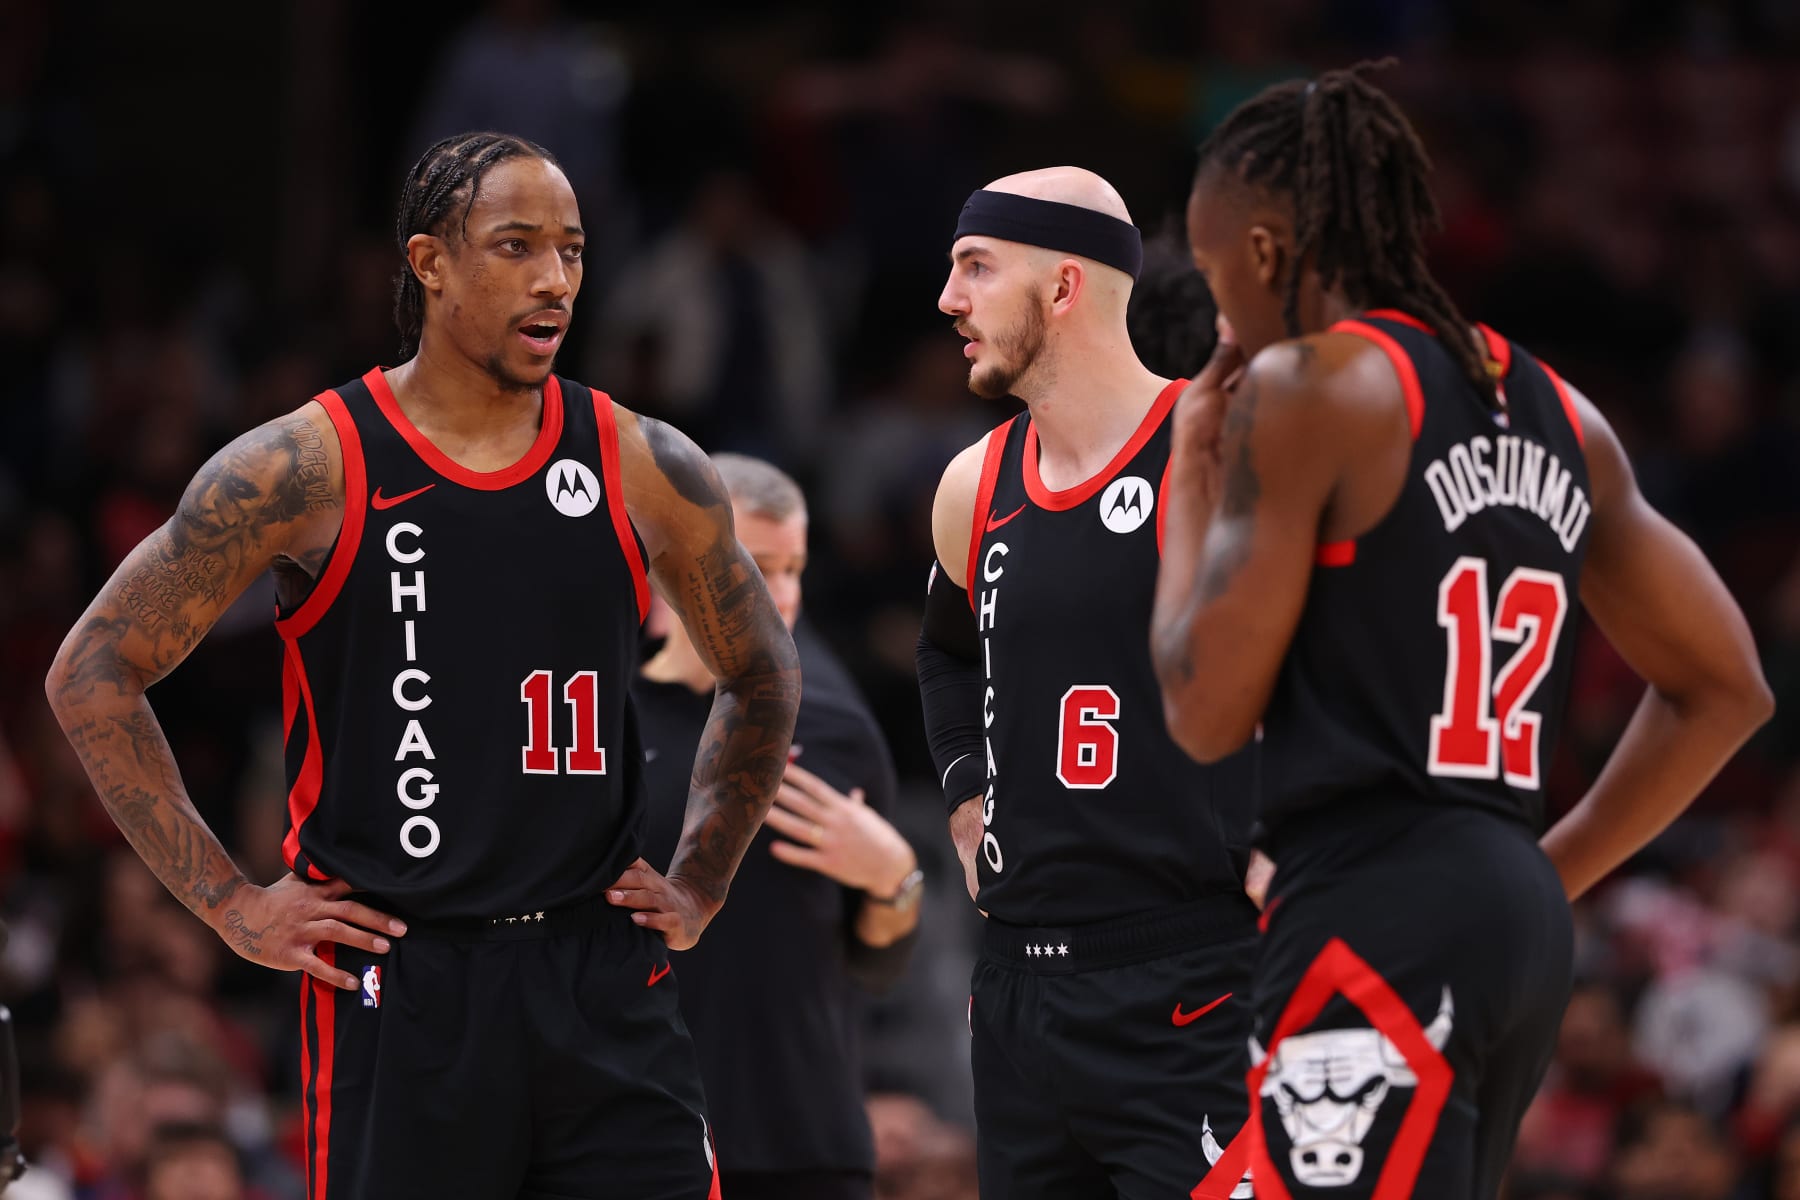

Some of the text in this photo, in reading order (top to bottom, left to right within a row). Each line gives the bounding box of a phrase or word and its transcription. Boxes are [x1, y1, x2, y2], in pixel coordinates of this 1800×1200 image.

[1423, 434, 1592, 554] DOSUNMU
[385, 521, 441, 858] CHICAGO
[520, 669, 607, 776] 11
[977, 541, 1010, 874] CHICAGO
[1055, 684, 1121, 790] 6
[1427, 556, 1568, 790] 12
